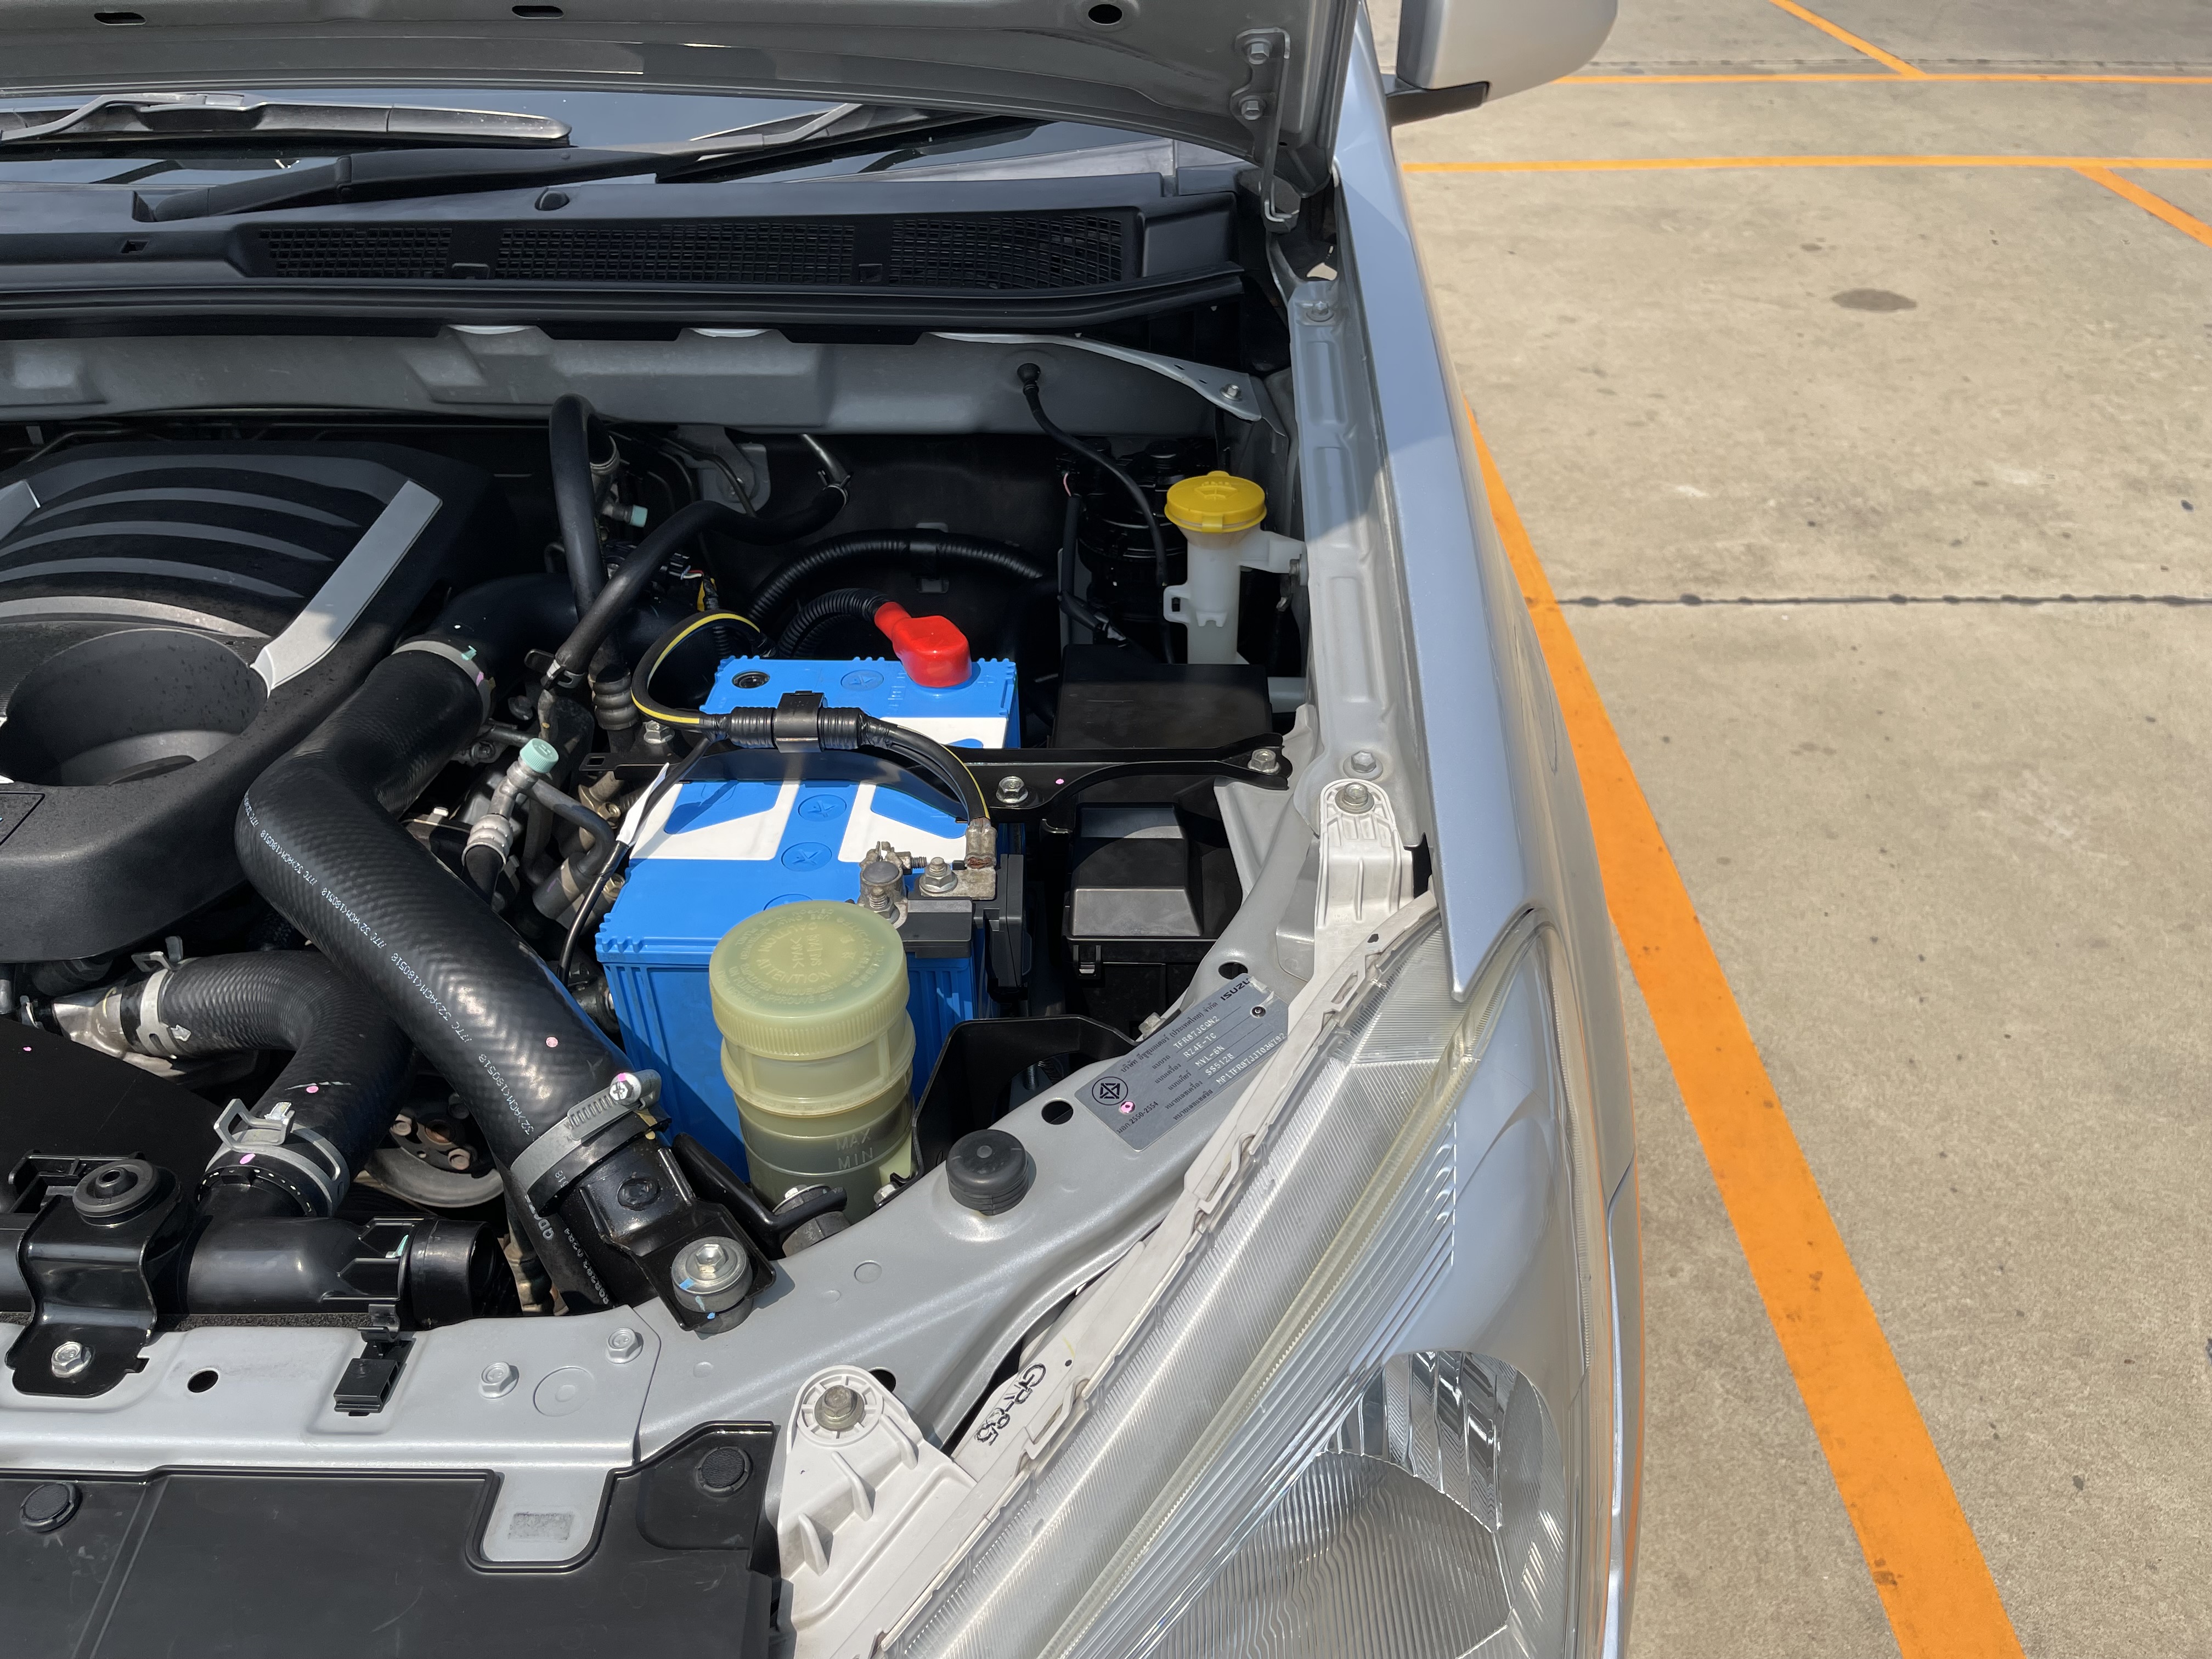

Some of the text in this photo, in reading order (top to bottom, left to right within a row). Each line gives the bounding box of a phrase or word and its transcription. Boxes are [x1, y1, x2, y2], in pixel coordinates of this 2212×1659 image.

[757, 959, 832, 984] ATTENTION
[1220, 978, 1251, 1001] ISUZU
[1121, 1058, 1138, 1073] บริษัท
[1170, 1011, 1205, 1039] (ประเทศไทย)
[1203, 1001, 1218, 1017] จำกัด
[1152, 1054, 1171, 1070] แบบรถ
[1154, 1032, 1217, 1085] แบบเครื่อง RZ4E-TC
[1194, 1045, 1226, 1068] MVL-6N
[1205, 1052, 1234, 1076] SS5128
[836, 1127, 871, 1151] MAX
[838, 1147, 873, 1170] MIN
